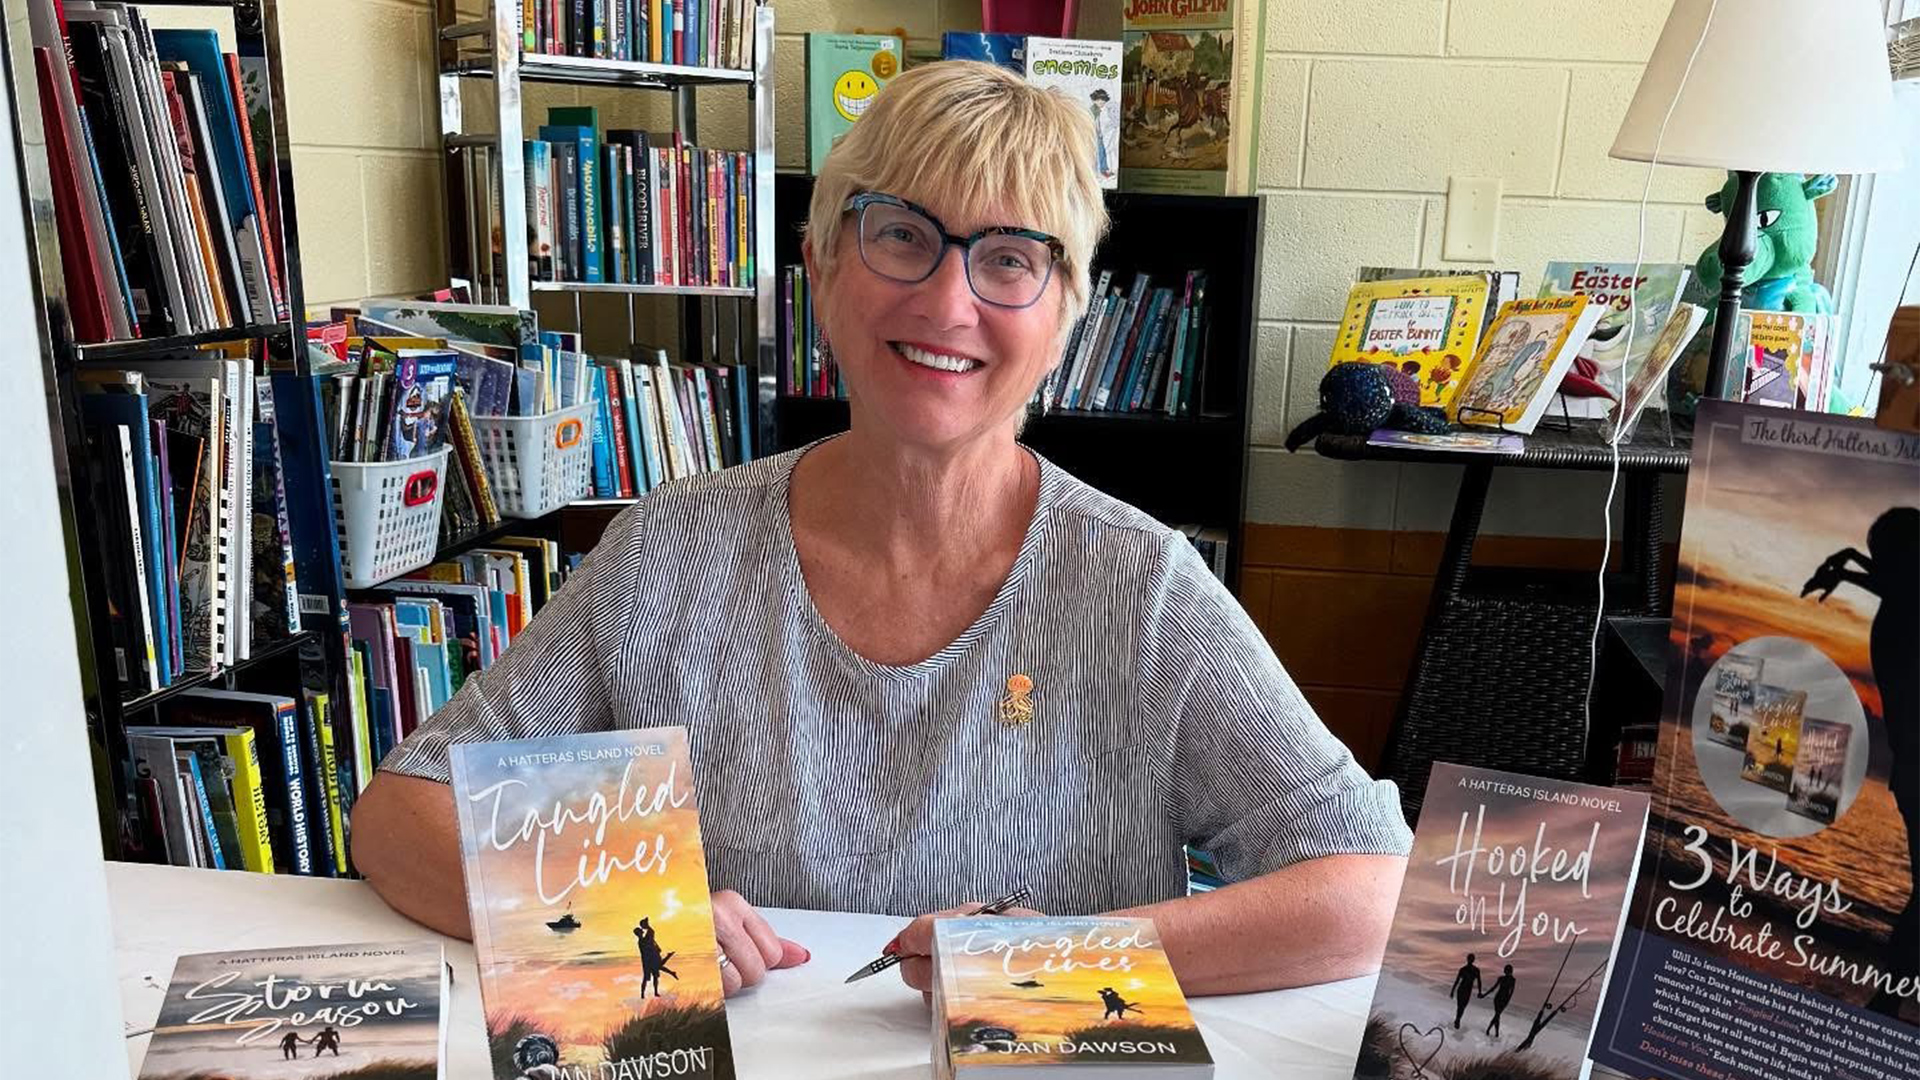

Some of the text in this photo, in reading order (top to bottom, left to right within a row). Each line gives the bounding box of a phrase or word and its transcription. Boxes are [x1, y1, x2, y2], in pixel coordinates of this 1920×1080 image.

[1033, 57, 1119, 79] enemies
[635, 168, 648, 209] BLOOD
[1571, 271, 1648, 290] Easter
[1751, 421, 1778, 441] The
[1780, 422, 1820, 446] third
[1823, 429, 1889, 457] Hatteras
[498, 745, 665, 767] A HATTERAS ISLAND NOVEL
[469, 758, 689, 851] Tangled
[1458, 778, 1622, 813] A HATTERAS ISLAND NOVEL
[289, 778, 311, 873] WORLD HISTORY
[536, 829, 673, 906] Lines
[1436, 804, 1600, 899] Hooked
[1668, 824, 1852, 929] 3 Ways
[1456, 878, 1588, 958] on You
[1730, 884, 1753, 918] to
[950, 926, 1153, 957] Tangled
[1655, 897, 1784, 961] Celebrate
[228, 954, 304, 965] HATTERAS
[308, 952, 360, 960] ISLAND
[1002, 951, 1136, 977] Lines
[184, 972, 396, 1011] Storm
[1664, 961, 1920, 1061] love? Can Dare set aside his feelings for Jo to make room
[1672, 949, 1691, 963] Will
[1692, 957, 1702, 967] Jo
[1703, 960, 1726, 976] leave
[1728, 969, 1767, 990] Hatteras
[1770, 984, 1798, 1001] Island
[1800, 995, 1833, 1014] behind
[1835, 1008, 1849, 1020] for
[1850, 1015, 1858, 1023] a
[1859, 1018, 1880, 1030] new
[1881, 1025, 1914, 1042] career
[187, 998, 418, 1044] Season
[1653, 1000, 1674, 1014] don't
[1674, 1006, 1700, 1024] forget
[1702, 1016, 1720, 1030] how
[1722, 1026, 1729, 1035] it
[1730, 1030, 1743, 1039] all
[1744, 1035, 1778, 1053] started.
[1780, 1046, 1808, 1064] Begin
[1810, 1060, 1831, 1073] with
[1654, 974, 1695, 993] romance?
[1696, 986, 1708, 999] It's
[1709, 992, 1721, 1004] all
[1722, 997, 1732, 1007] in
[1805, 1026, 1820, 1039] the
[1822, 1032, 1846, 1049] third
[1848, 1042, 1870, 1058] book
[1872, 1051, 1882, 1062] in
[1884, 1056, 1903, 1070] this
[1656, 988, 1680, 1002] which
[1682, 996, 1710, 1014] brings
[1712, 1006, 1734, 1021] their
[1734, 1014, 1758, 1032] story
[1760, 1025, 1769, 1035] to
[1770, 1030, 1776, 1038] a
[1778, 1034, 1812, 1053] moving
[1814, 1047, 1833, 1058] and
[1834, 1054, 1885, 1079] surprising
[600, 1046, 707, 1080] DAWSON
[998, 1041, 1177, 1055] JAN DAWSON
[1640, 1040, 1668, 1057] Don't
[1669, 1053, 1694, 1068] miss
[1696, 1064, 1724, 1080] these
[1652, 1015, 1700, 1039] characters,
[1704, 1032, 1723, 1047] then
[1725, 1042, 1739, 1053] see
[1740, 1047, 1769, 1064] where
[1770, 1056, 1786, 1071] life
[1788, 1063, 1812, 1080] leads
[1714, 1050, 1736, 1066] Each
[1738, 1062, 1763, 1076] novel
